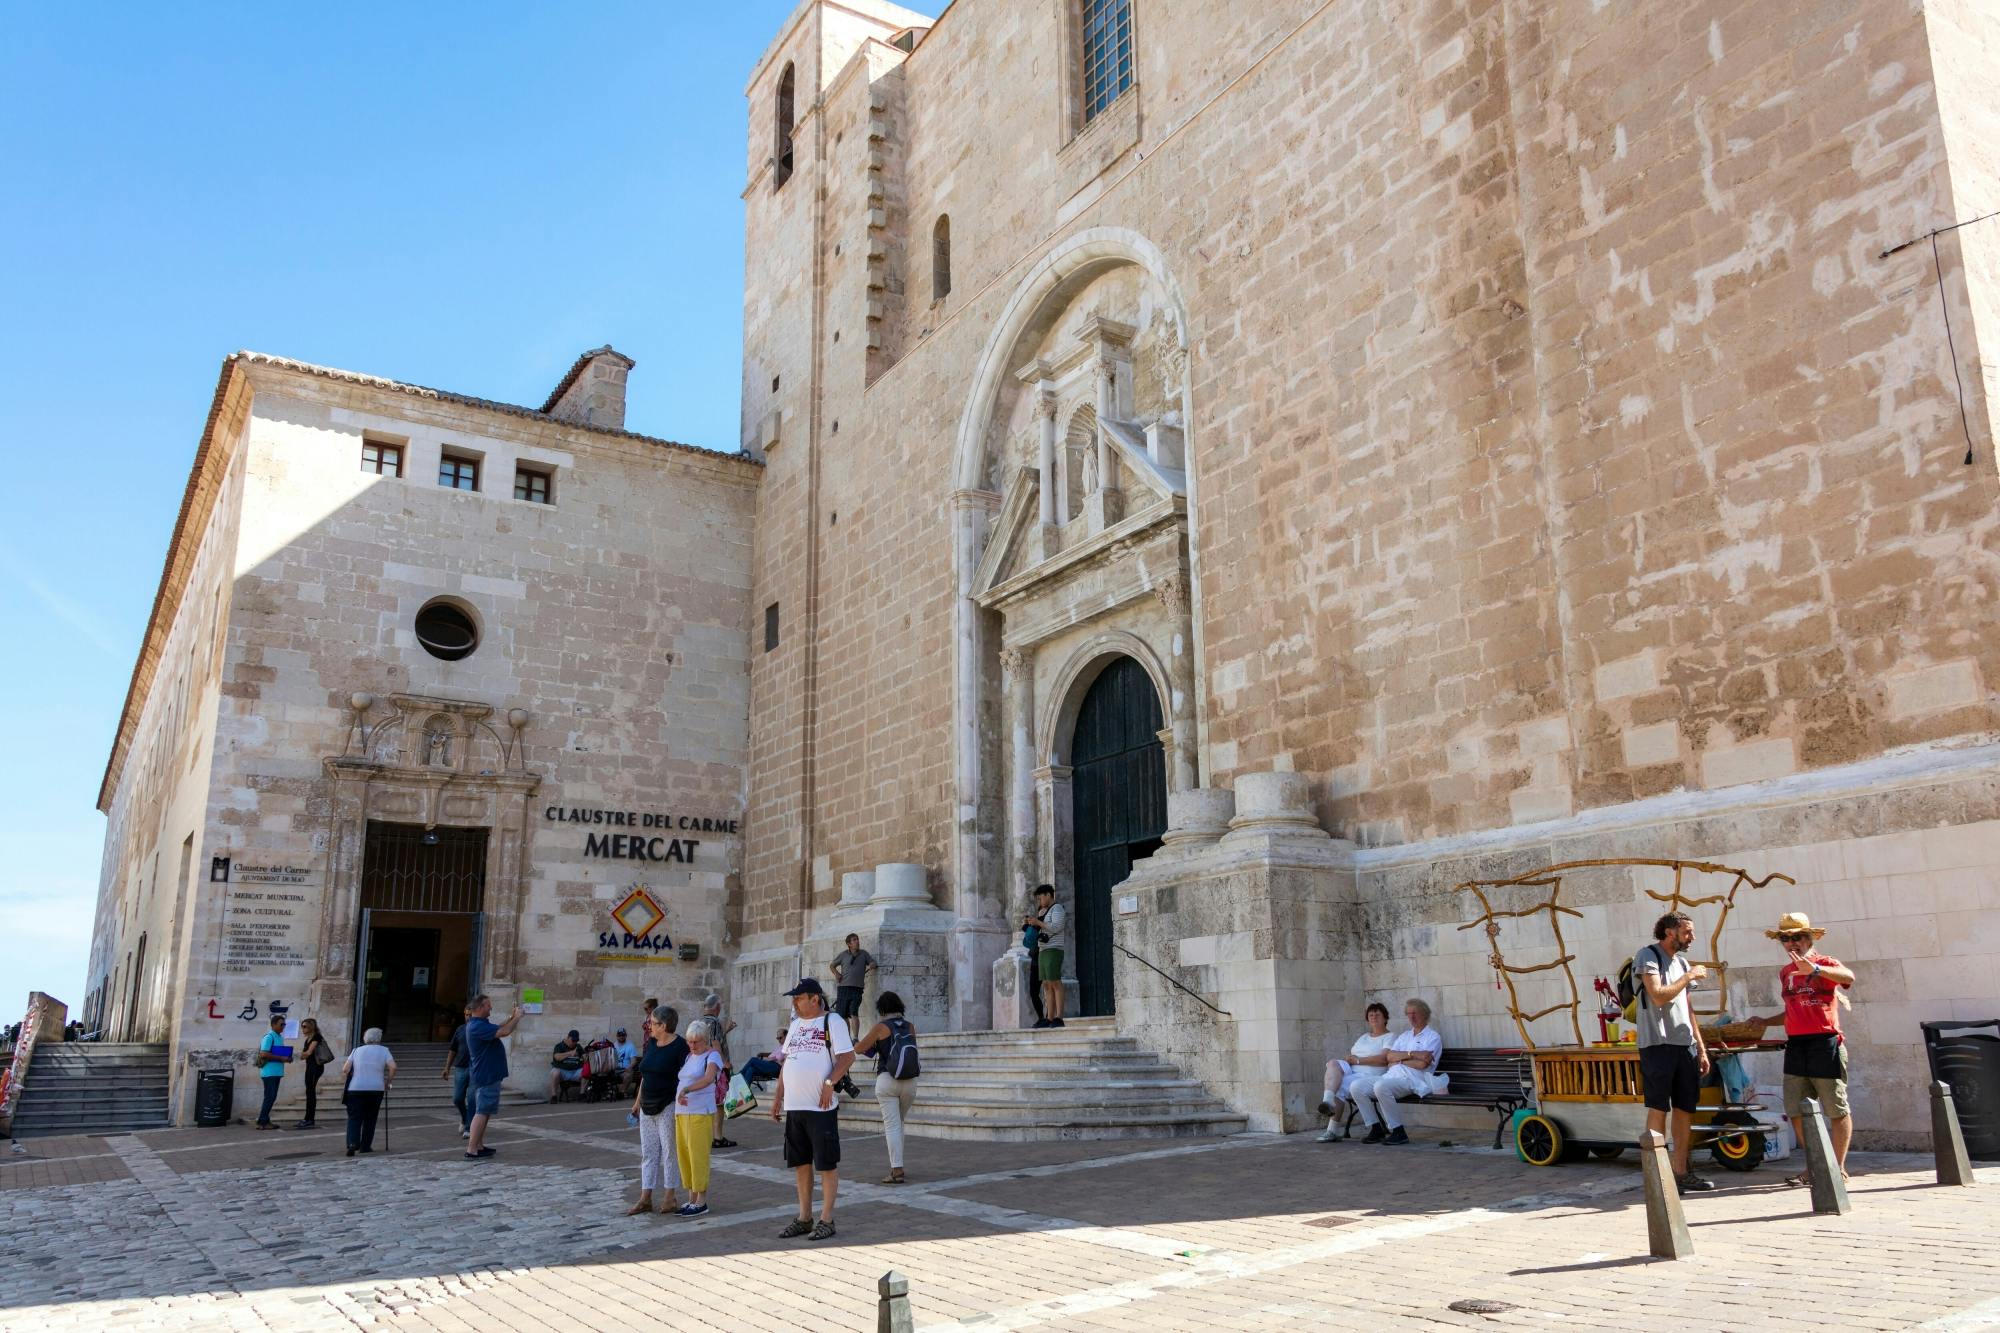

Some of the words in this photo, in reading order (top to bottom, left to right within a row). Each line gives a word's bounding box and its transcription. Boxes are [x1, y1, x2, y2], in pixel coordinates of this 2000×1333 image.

[545, 806, 637, 827] CLAUSTRE
[642, 814, 673, 829] DEL
[679, 816, 738, 834] CARME
[584, 832, 700, 864] MERCAT
[234, 863, 268, 873] Claustre
[270, 864, 282, 873] del
[284, 865, 312, 874] Carme
[233, 892, 264, 900] MERCAT
[266, 893, 306, 902] MUNICIPAL
[599, 931, 619, 949] SA
[623, 931, 673, 955] PLAÇA
